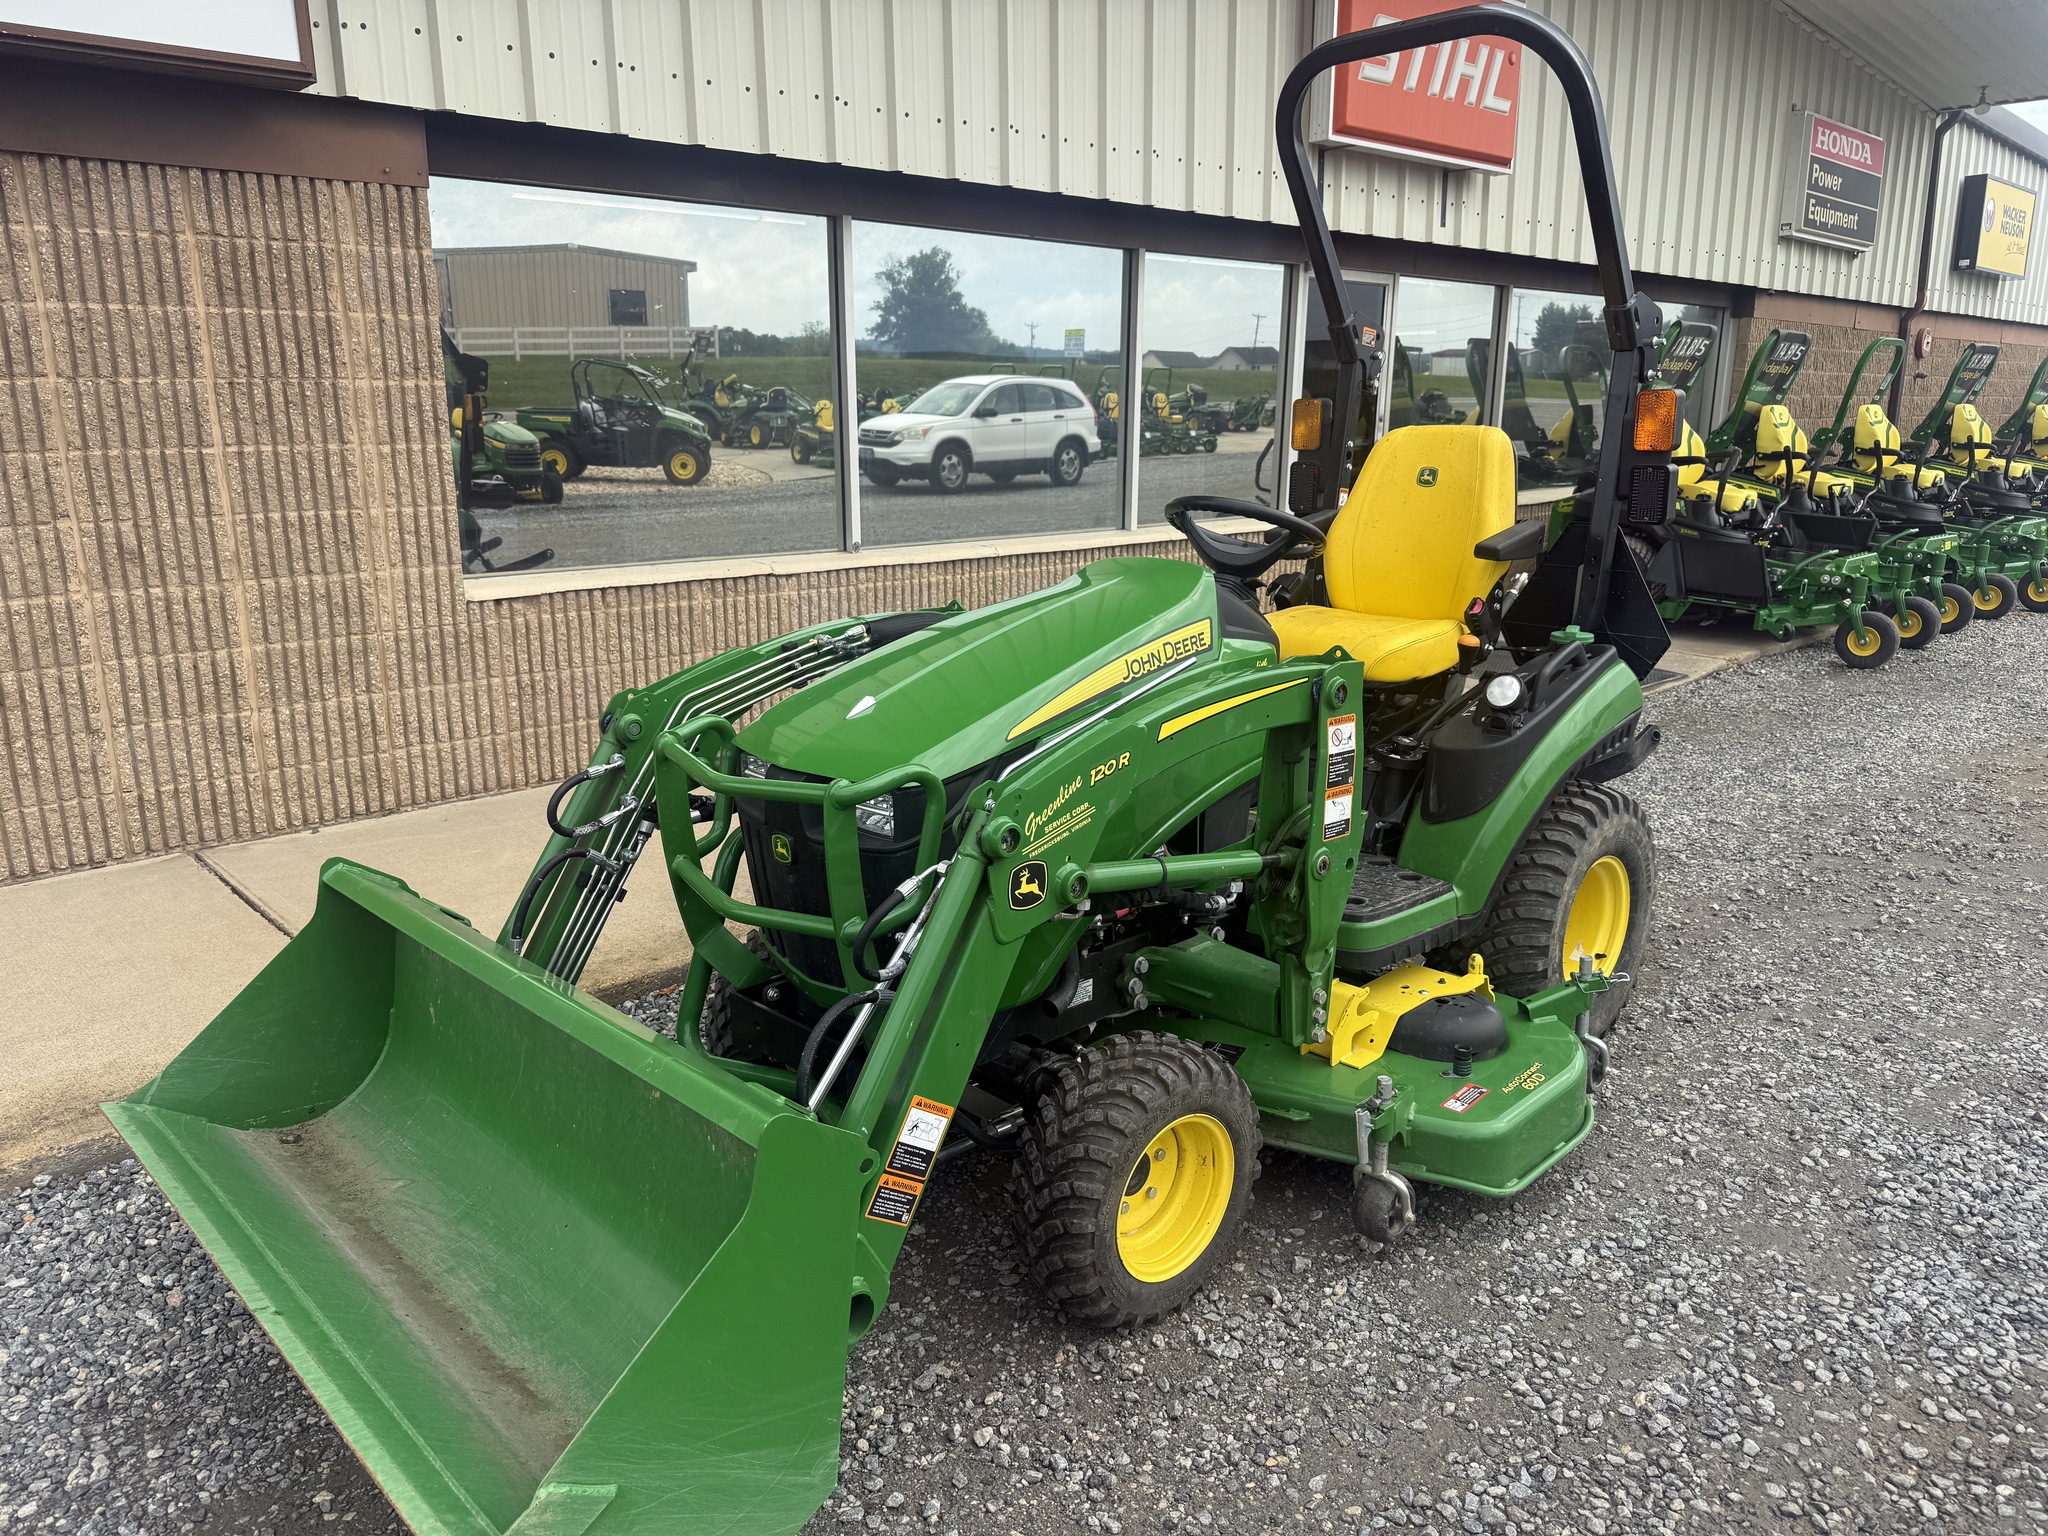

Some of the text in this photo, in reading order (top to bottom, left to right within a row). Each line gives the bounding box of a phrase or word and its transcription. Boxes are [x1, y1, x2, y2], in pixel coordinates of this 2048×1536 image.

[1357, 13, 1512, 116] STIHL
[1815, 126, 1873, 166] HONDA
[1811, 163, 1843, 192] Power
[1807, 198, 1859, 231] Equipment
[1999, 219, 2026, 240] NEUSON
[2002, 203, 2027, 225] WACKER
[1122, 632, 1208, 683] JOHN DEERE
[1333, 714, 1355, 725] WARNING
[1025, 774, 1083, 842] Greenline
[1330, 790, 1352, 799] WARNING
[1043, 801, 1091, 834] SERVICE CORP.
[1029, 817, 1092, 859] FREDERICKSBURG, VIRGINIA
[1501, 1061, 1543, 1094] AutoConnect
[1521, 1072, 1546, 1090] 60D
[923, 1101, 949, 1115] WARNING
[891, 1180, 918, 1193] WARNING
